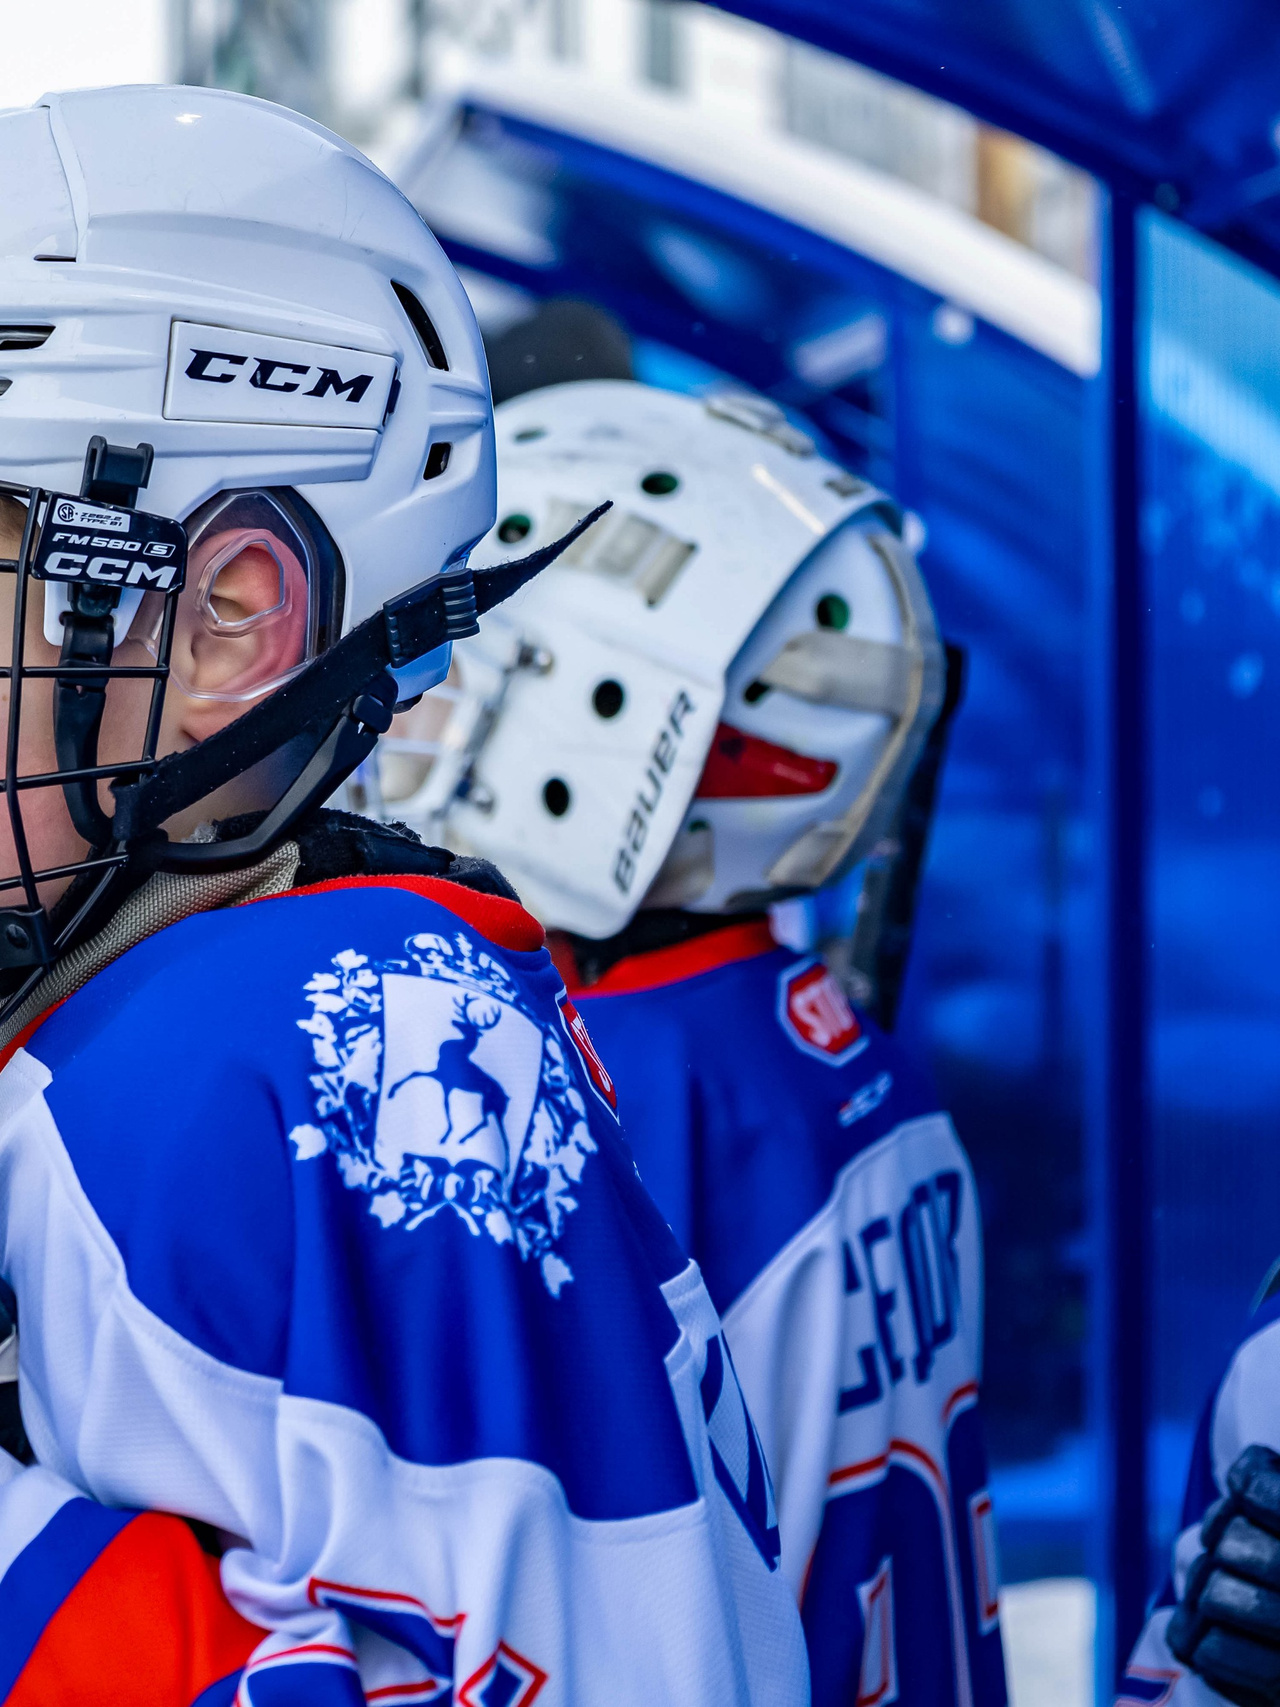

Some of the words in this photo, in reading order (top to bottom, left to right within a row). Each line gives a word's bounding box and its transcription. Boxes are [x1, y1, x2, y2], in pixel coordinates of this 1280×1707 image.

[185, 349, 374, 403] CCM
[80, 518, 108, 526] TYPE
[44, 551, 177, 588] CCM
[612, 690, 694, 896] BAUER
